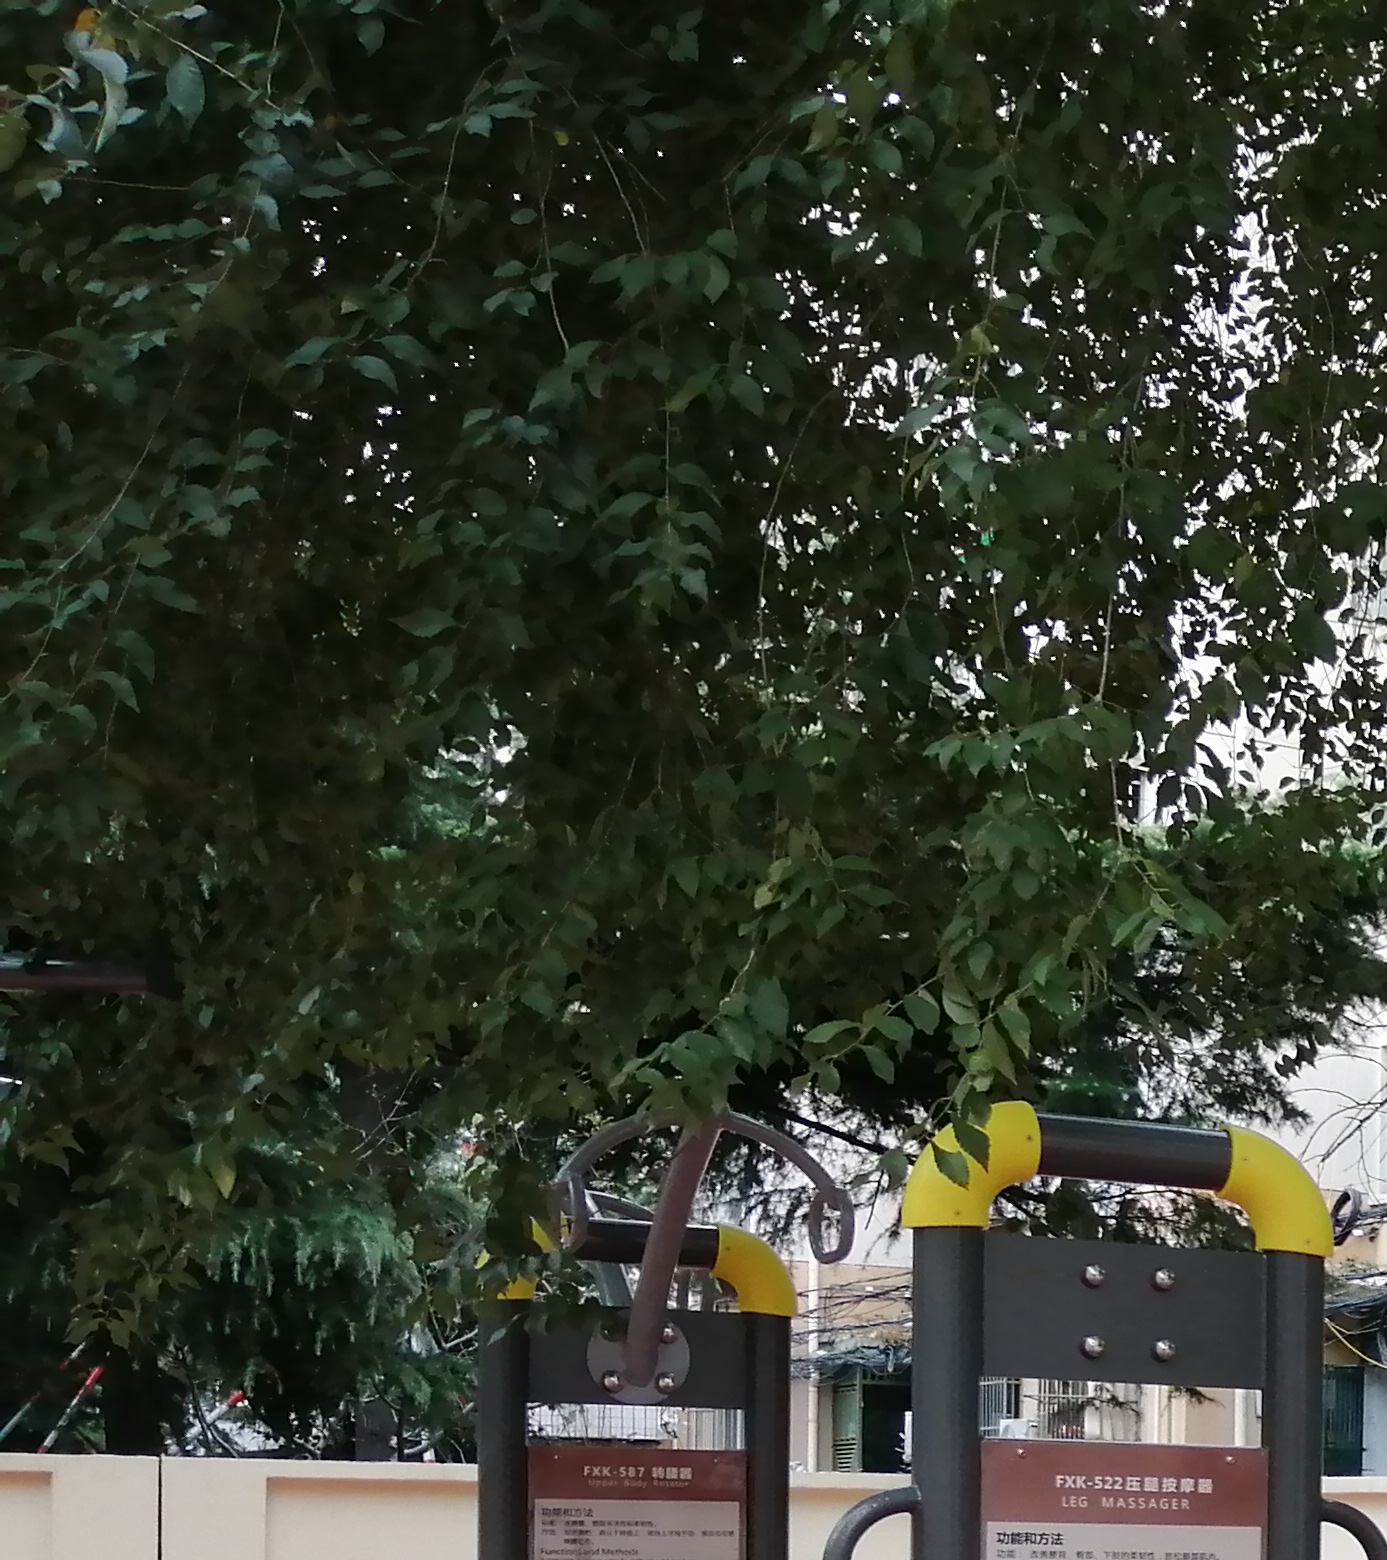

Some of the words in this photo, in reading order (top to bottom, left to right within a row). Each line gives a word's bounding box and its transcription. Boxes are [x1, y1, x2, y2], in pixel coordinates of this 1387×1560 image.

[583, 1466, 645, 1477] FXK-587
[1061, 1495, 1087, 1507] LEG
[1101, 1496, 1189, 1509] MASSAGER
[996, 1531, 1063, 1545] 功能和方法
